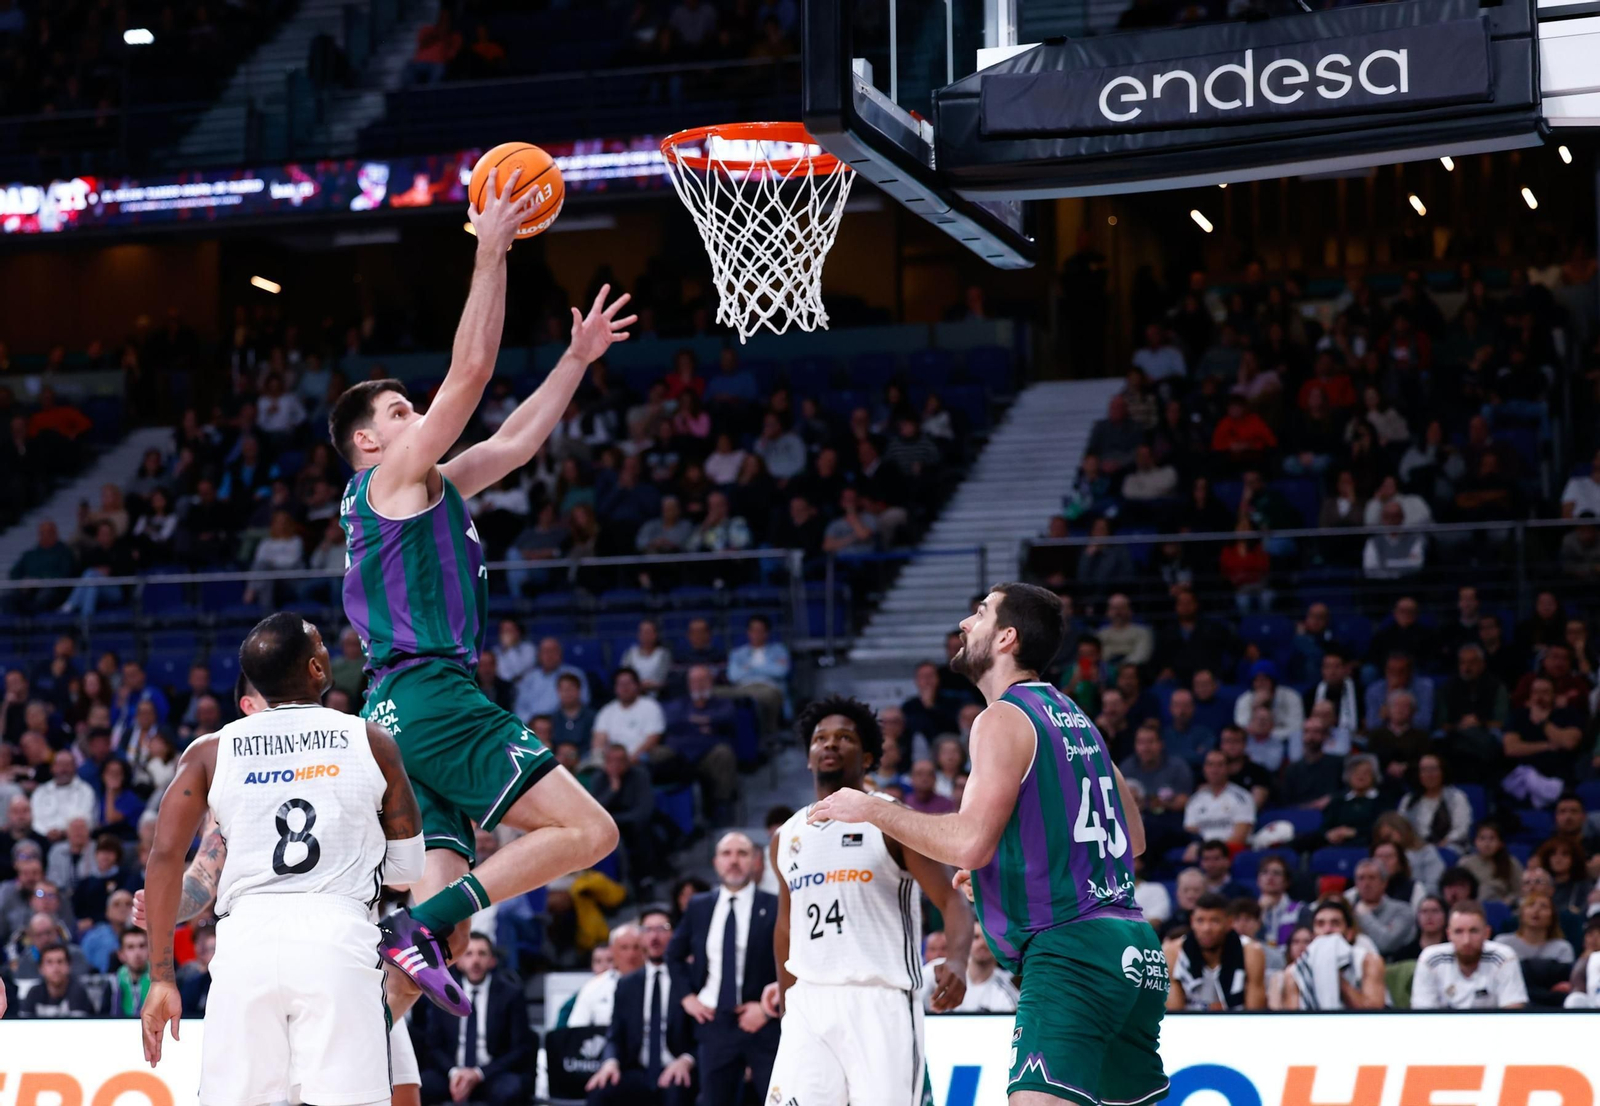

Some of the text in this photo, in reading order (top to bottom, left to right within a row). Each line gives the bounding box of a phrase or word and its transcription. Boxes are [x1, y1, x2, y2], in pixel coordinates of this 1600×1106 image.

[1098, 48, 1408, 122] endesa
[233, 729, 349, 757] RATHAN-MAYES
[244, 764, 340, 784] AUTOHERO
[1073, 776, 1127, 859] 45
[272, 798, 321, 875] 8
[807, 899, 844, 940] 24
[1143, 949, 1166, 964] COS
[1146, 965, 1164, 978] DEL
